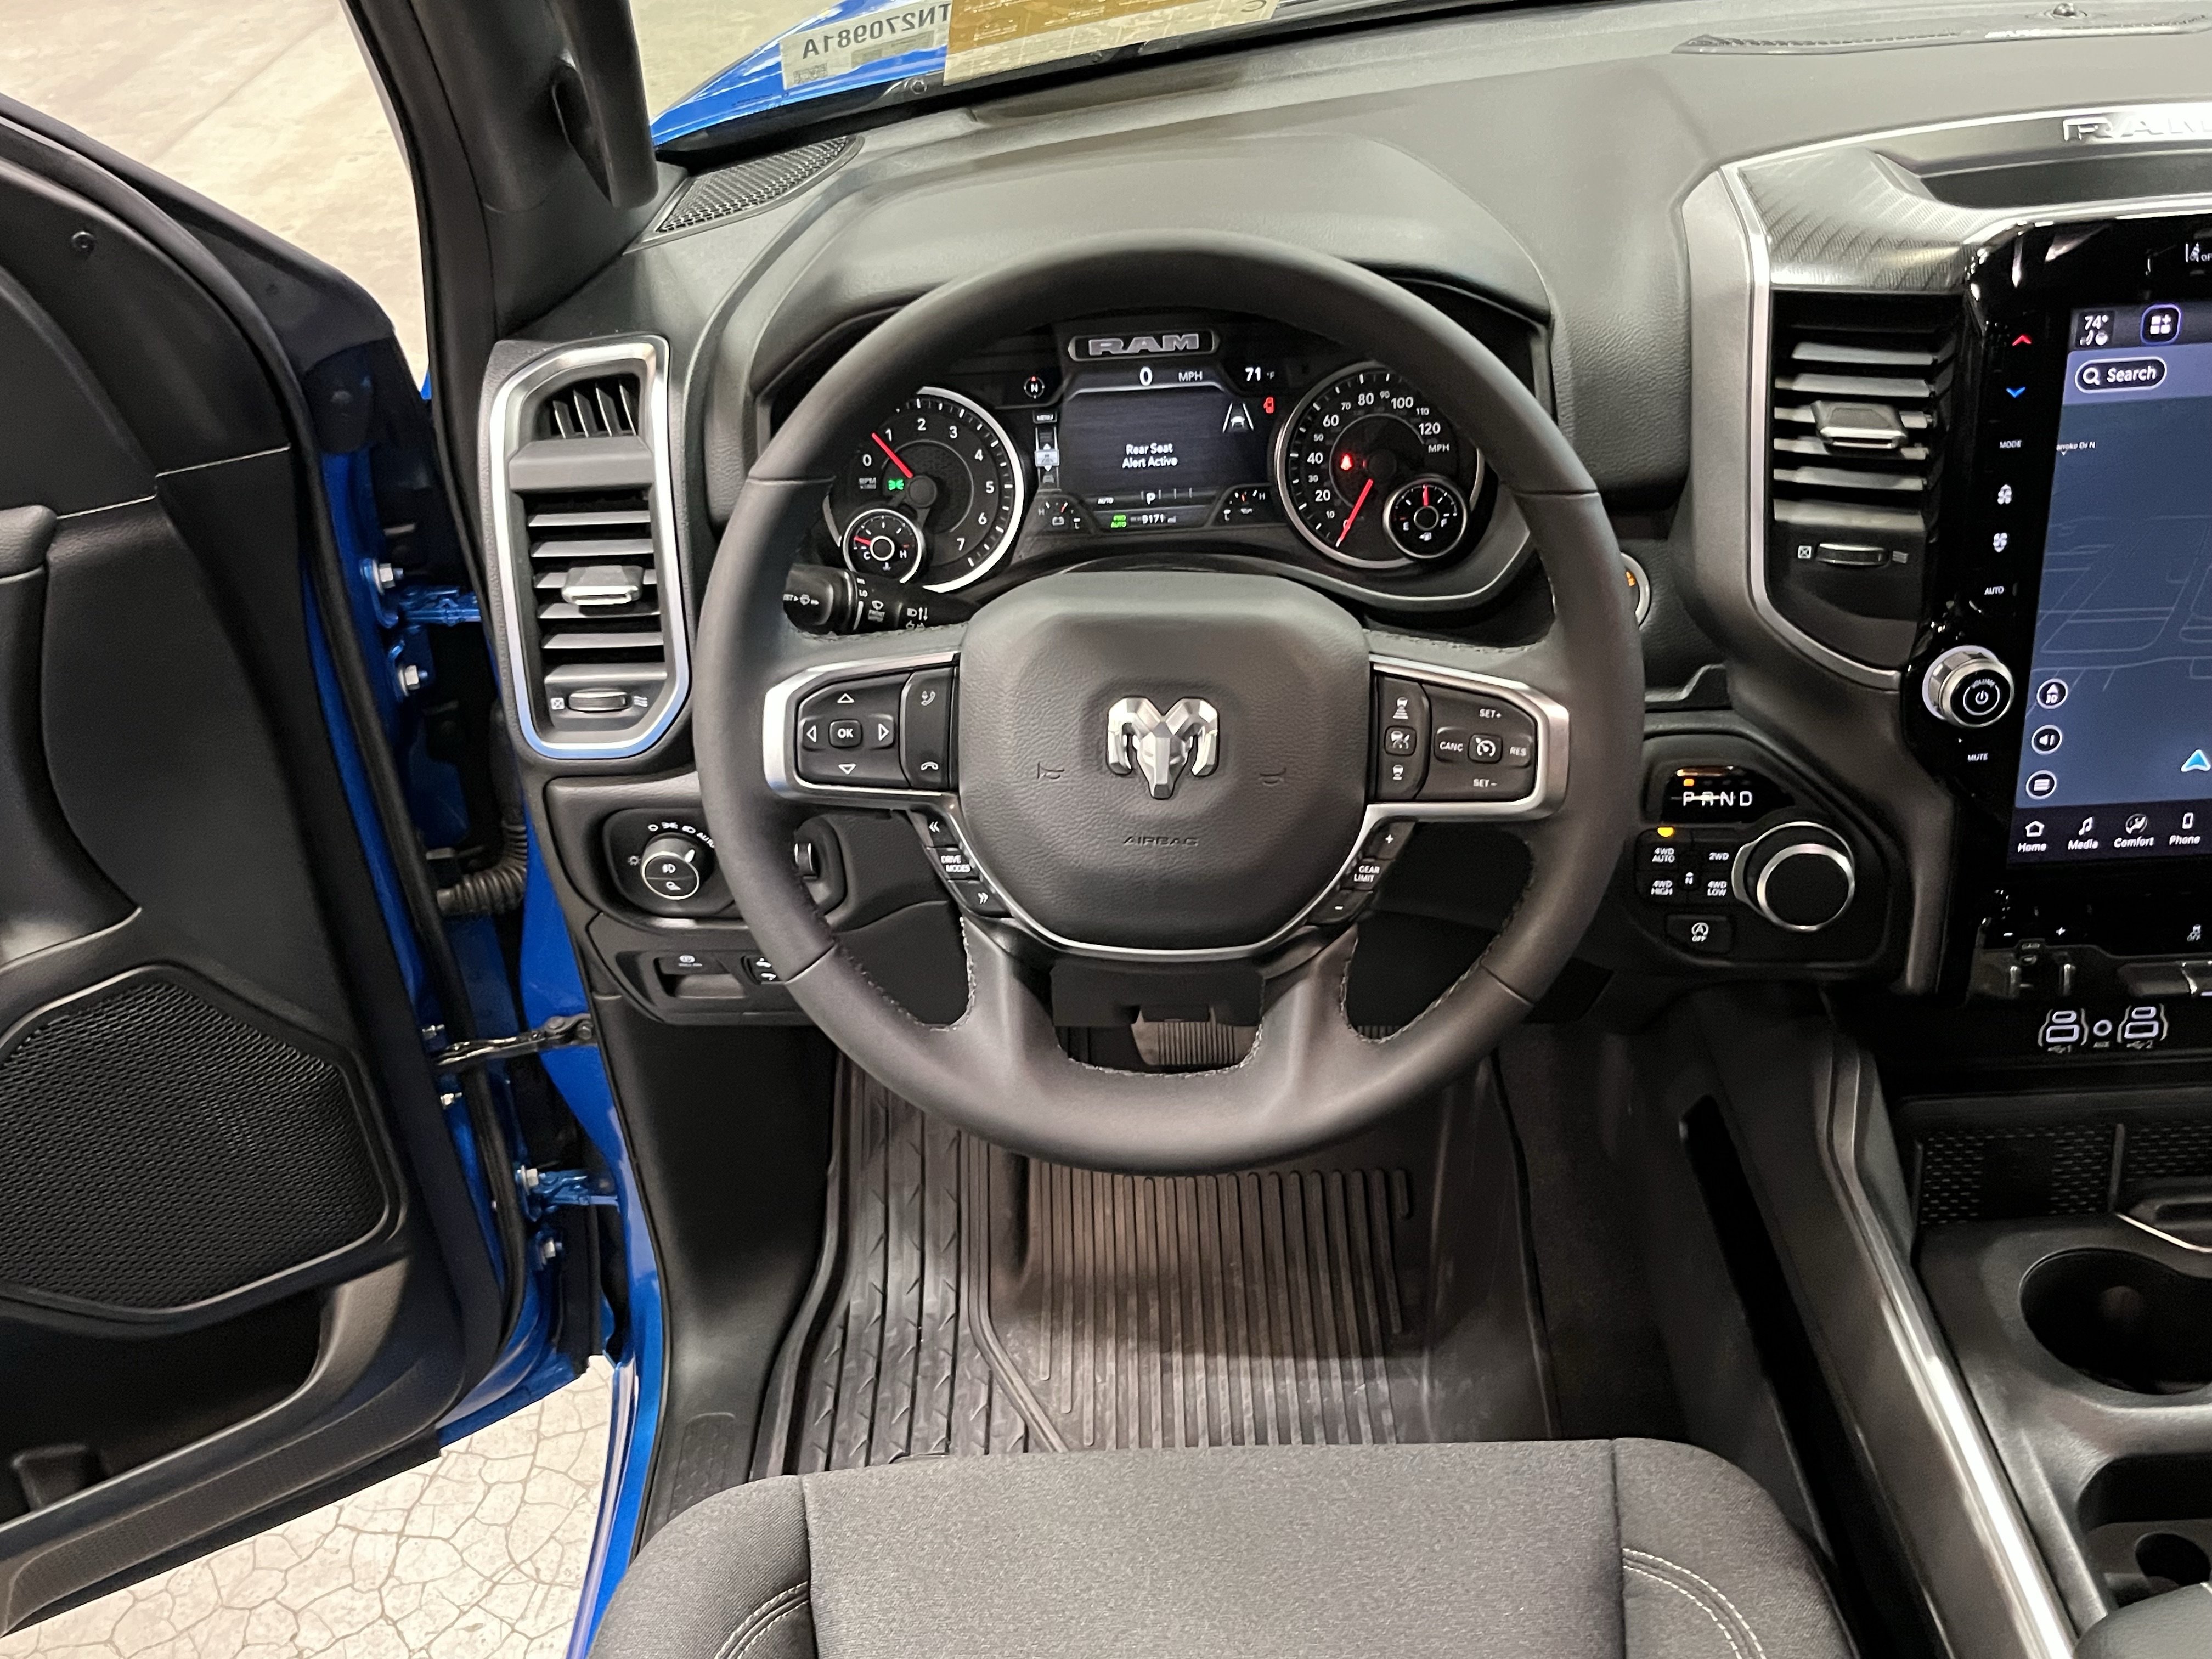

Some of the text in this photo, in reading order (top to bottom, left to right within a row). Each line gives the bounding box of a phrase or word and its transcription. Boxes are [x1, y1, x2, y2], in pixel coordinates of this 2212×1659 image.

[1088, 334, 1199, 356] RAM
[1139, 366, 1203, 386] 0 MPH
[1245, 367, 1261, 382] 71
[2107, 365, 2157, 383] Search
[1031, 384, 1038, 392] N
[1358, 393, 1374, 406] 80
[1380, 391, 1390, 399] 90
[1341, 402, 1351, 411] 70
[1391, 397, 1414, 409] 100
[1415, 407, 1430, 416] 110
[917, 418, 926, 431] 2
[1323, 415, 1339, 427] 60
[949, 426, 958, 438] 3
[1418, 422, 1441, 435] 120
[885, 428, 892, 441] 1
[1313, 433, 1324, 442] 50
[1126, 443, 1173, 455] Rear Seat
[1428, 444, 1450, 453] MPH
[2000, 440, 2022, 448] MODE
[862, 454, 872, 466] 0
[974, 449, 983, 461] 4
[1307, 453, 1323, 464] 40
[1122, 455, 1178, 468] Alert Active
[985, 481, 995, 493] 5
[1147, 492, 1156, 505] P
[1315, 489, 1331, 502] 20
[978, 512, 988, 525] 6
[1325, 510, 1335, 518] 10
[956, 538, 965, 551] 7
[863, 551, 871, 560] C
[899, 550, 907, 558] H
[1984, 586, 2004, 595] AUTO
[837, 729, 853, 738] OK
[1440, 741, 1463, 752] CANC
[1510, 746, 1527, 757] RES
[1967, 753, 1988, 761] MUTE
[1683, 791, 1695, 806] P
[1720, 791, 1734, 806] N
[1740, 791, 1753, 806] D
[1123, 836, 1198, 847] AIRBAG
[2068, 839, 2098, 850] Media
[2114, 837, 2154, 848] Comfort
[2169, 834, 2201, 845] Phone
[2018, 843, 2047, 852] Home
[941, 855, 961, 864] DRIVE
[1652, 854, 1675, 863] AUTO
[1709, 852, 1729, 861] 2WD
[1358, 865, 1380, 874] GEAR
[1354, 874, 1374, 882] LIMIT
[1707, 888, 1726, 896] LOW
